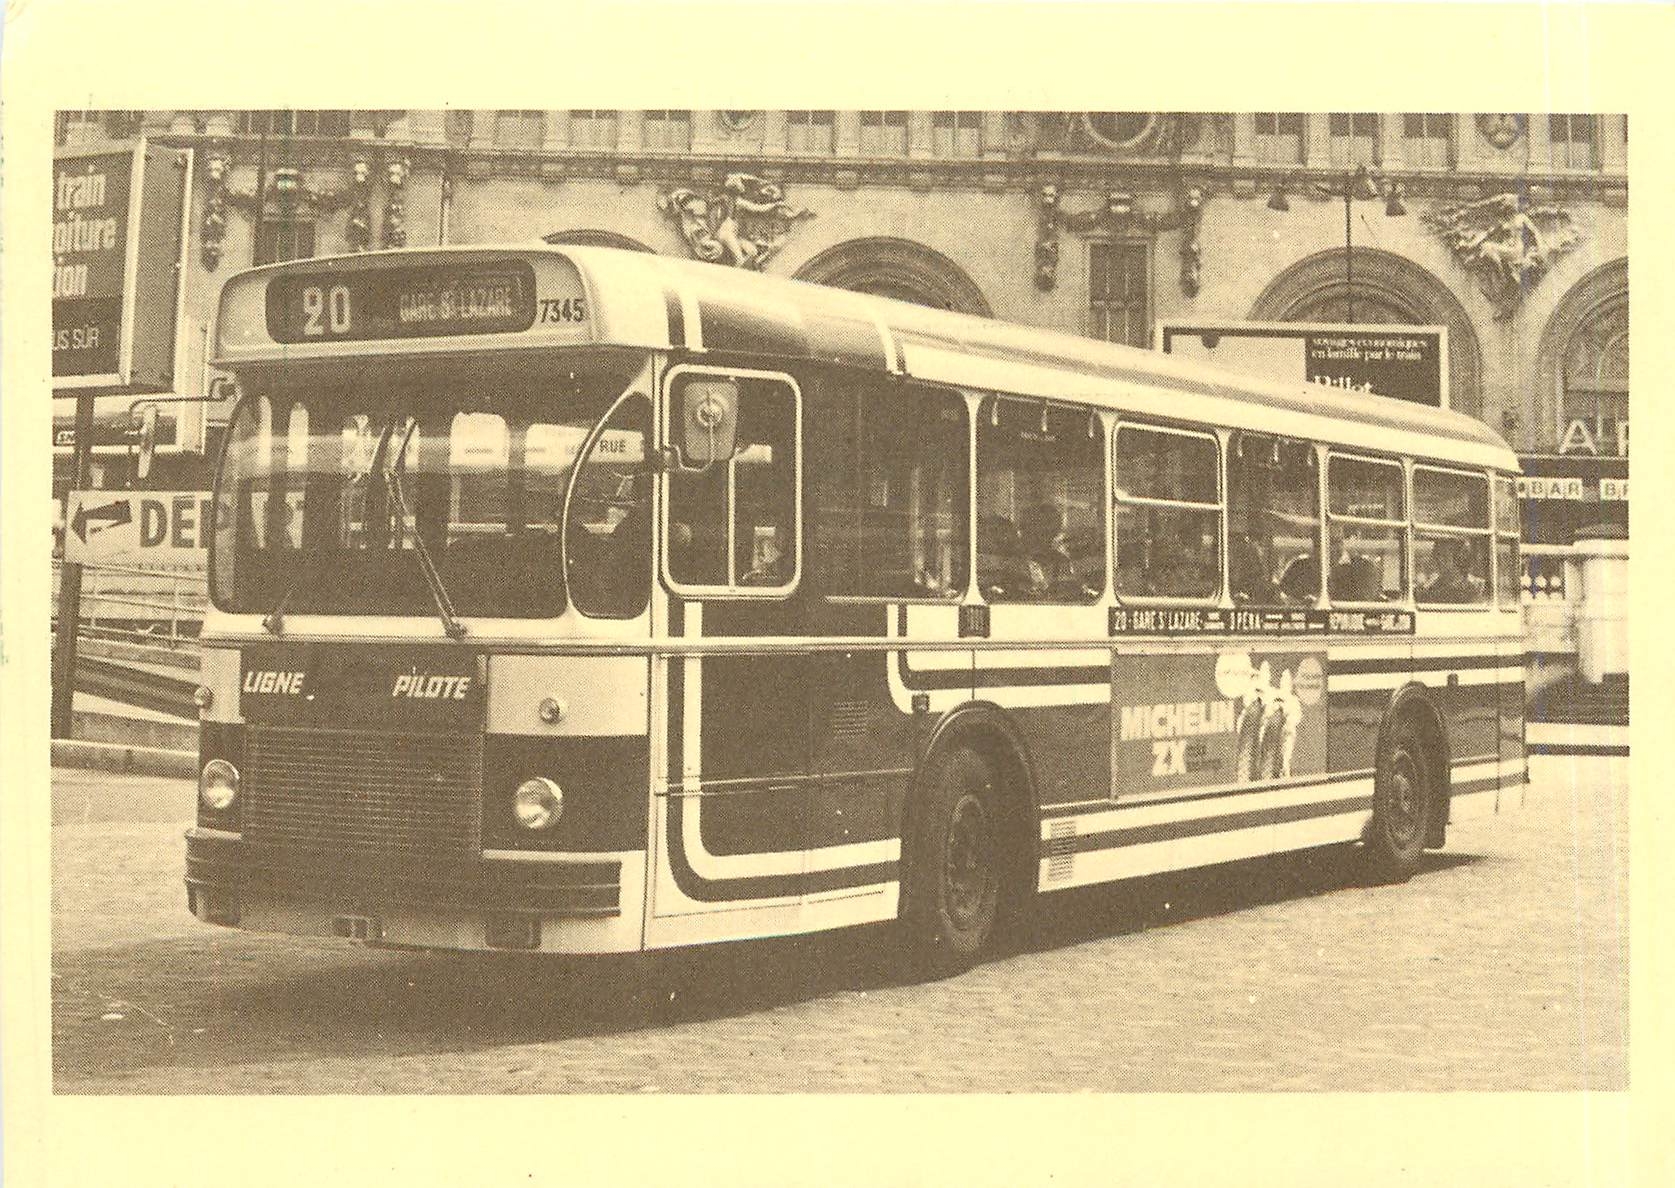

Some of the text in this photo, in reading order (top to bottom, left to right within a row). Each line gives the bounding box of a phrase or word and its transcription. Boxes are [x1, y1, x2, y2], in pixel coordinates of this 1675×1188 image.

[56, 164, 107, 211] train
[53, 211, 117, 255] oiture
[303, 285, 350, 336] 20
[400, 292, 436, 322] GARE
[461, 286, 512, 318] LAZARE
[539, 298, 585, 323] 7345
[599, 439, 626, 454] RUE
[1531, 481, 1580, 496] BAR
[1114, 610, 1127, 631] 20
[243, 671, 471, 700] LIGNE PILOTE
[1121, 700, 1236, 741] MICHELIN
[1152, 739, 1187, 777] ZX
